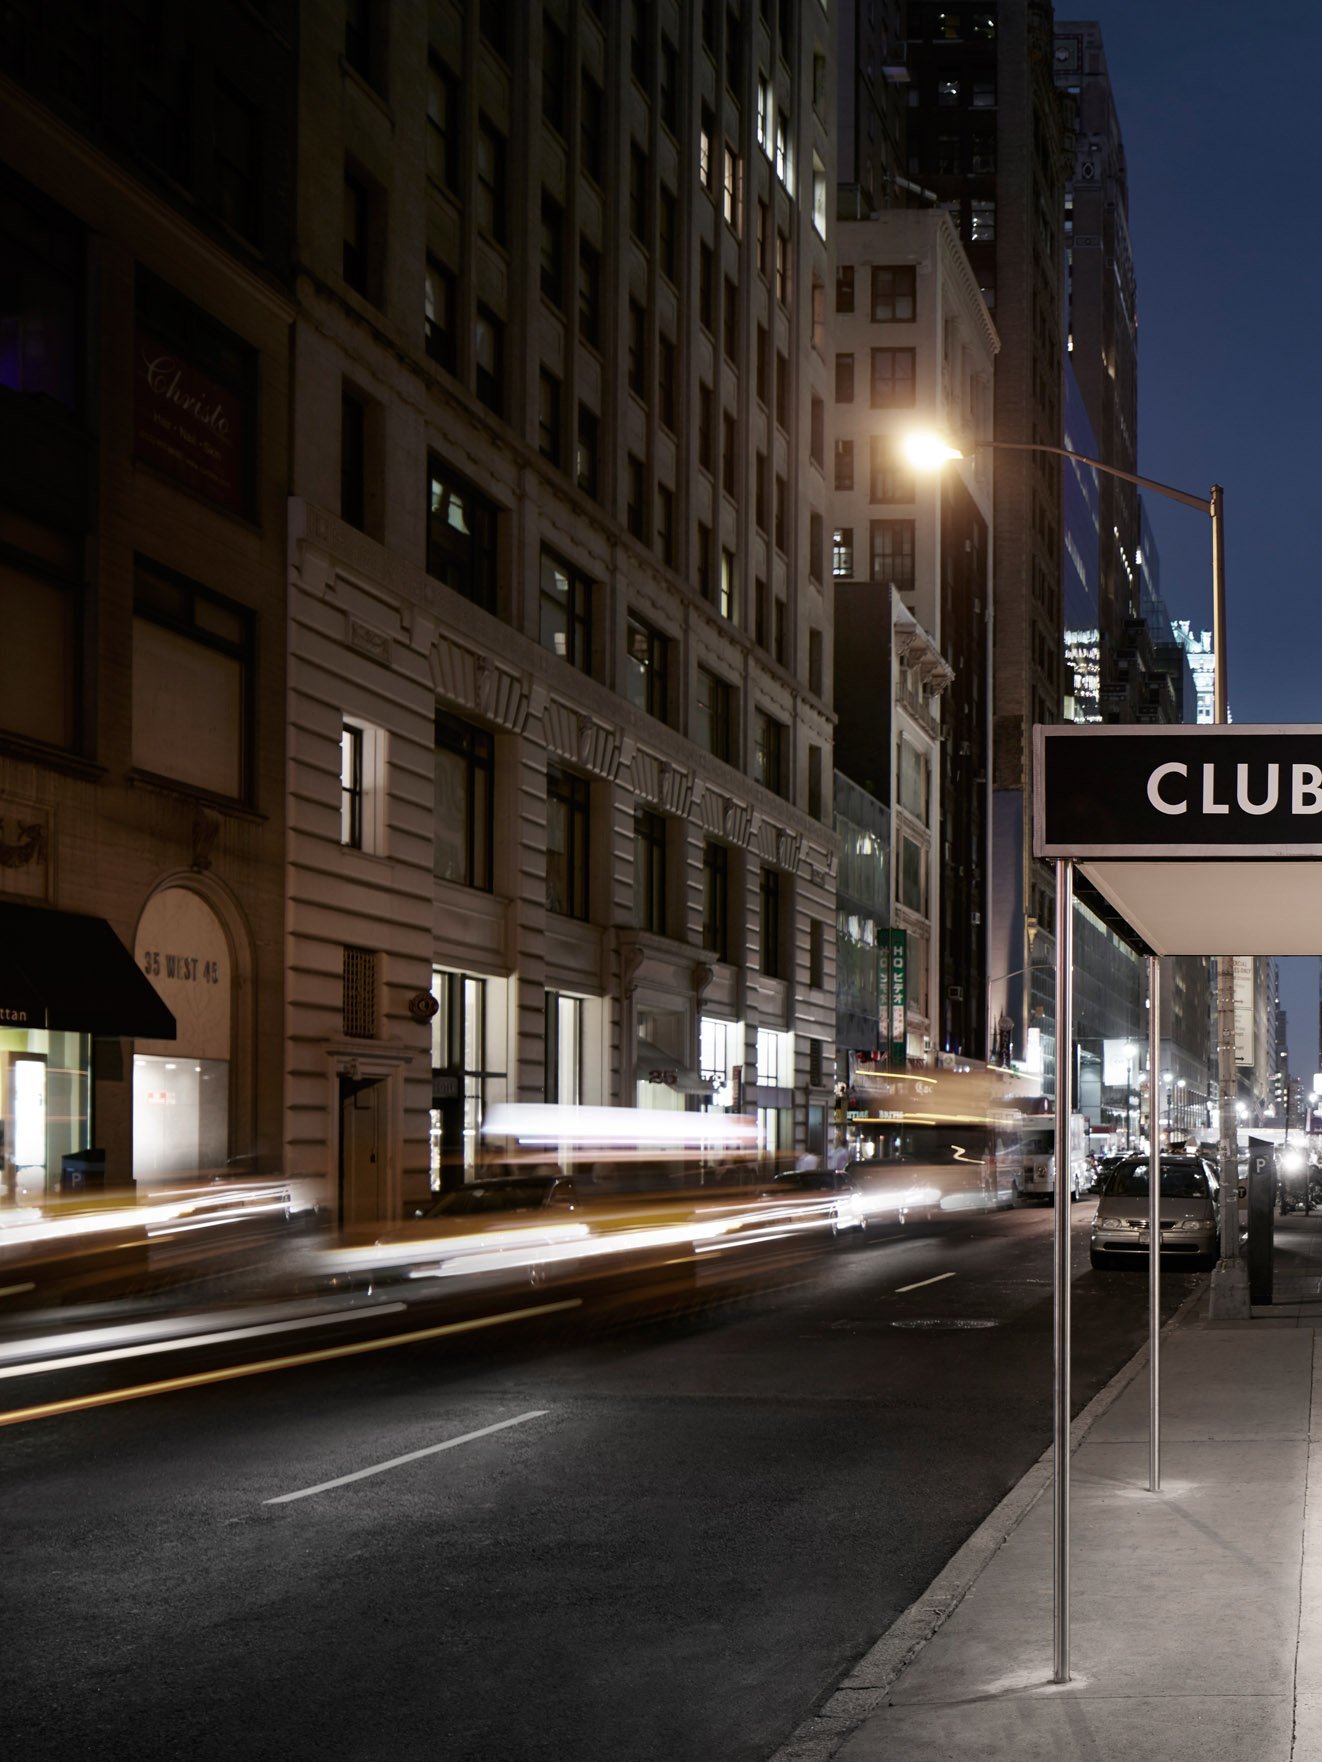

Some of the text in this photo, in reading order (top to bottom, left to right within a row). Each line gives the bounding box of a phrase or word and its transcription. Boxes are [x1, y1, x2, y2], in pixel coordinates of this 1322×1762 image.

[142, 347, 230, 433] Christo
[144, 951, 219, 984] 35 WEST 45
[1256, 1158, 1266, 1173] P
